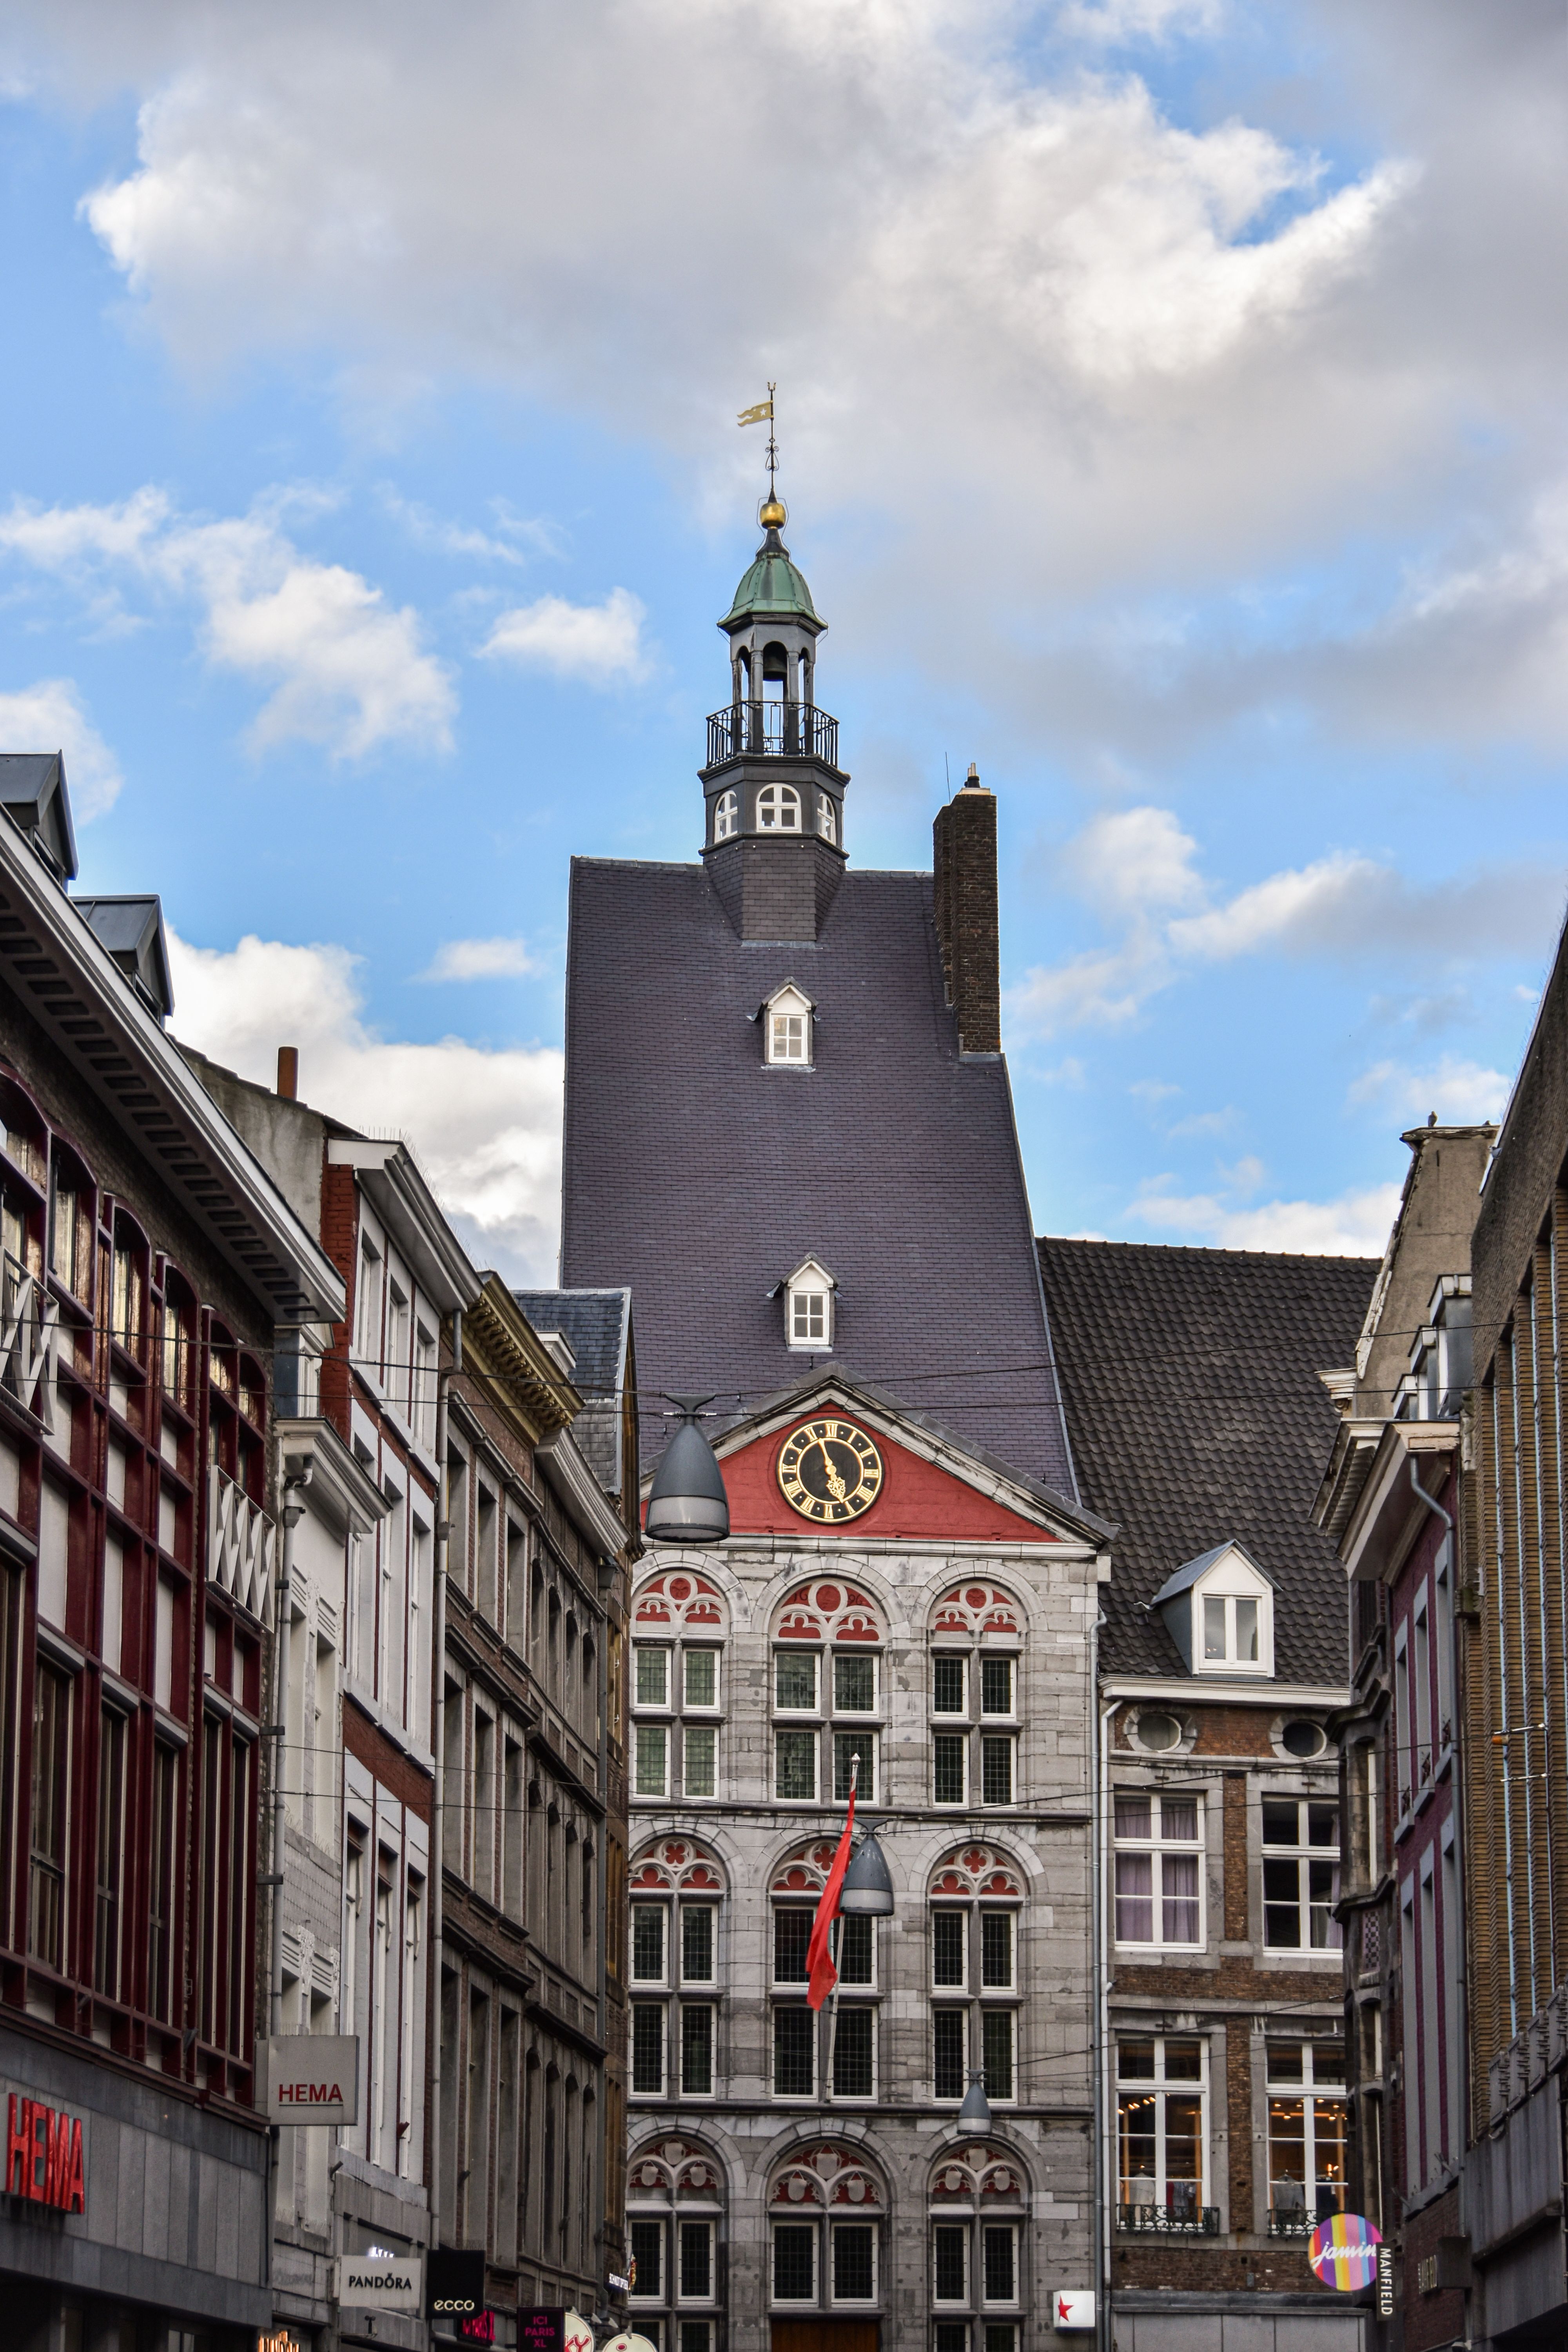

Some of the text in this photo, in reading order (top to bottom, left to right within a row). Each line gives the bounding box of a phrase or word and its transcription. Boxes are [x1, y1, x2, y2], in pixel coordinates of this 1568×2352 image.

[804, 1426, 818, 1442] XI
[826, 1423, 838, 1437] XII
[847, 1430, 857, 1444] I
[788, 1442, 802, 1454] X
[860, 1447, 874, 1458] II
[782, 1463, 797, 1473] IX
[864, 1469, 879, 1478] III
[785, 1480, 802, 1498] VIII
[857, 1485, 874, 1502] IIII
[800, 1496, 815, 1513] VII
[824, 1504, 834, 1519] VI
[844, 1501, 856, 1515] V
[279, 2084, 343, 2102] HEMA
[5, 2092, 85, 2215] HEMA
[1310, 2241, 1377, 2269] jamin
[348, 2273, 412, 2289] PANDORA
[1380, 2248, 1393, 2315] MANFIELD
[434, 2299, 475, 2311] ecco
[534, 2316, 548, 2325] ICI
[525, 2327, 555, 2336] PARIS
[534, 2339, 547, 2348] XL
